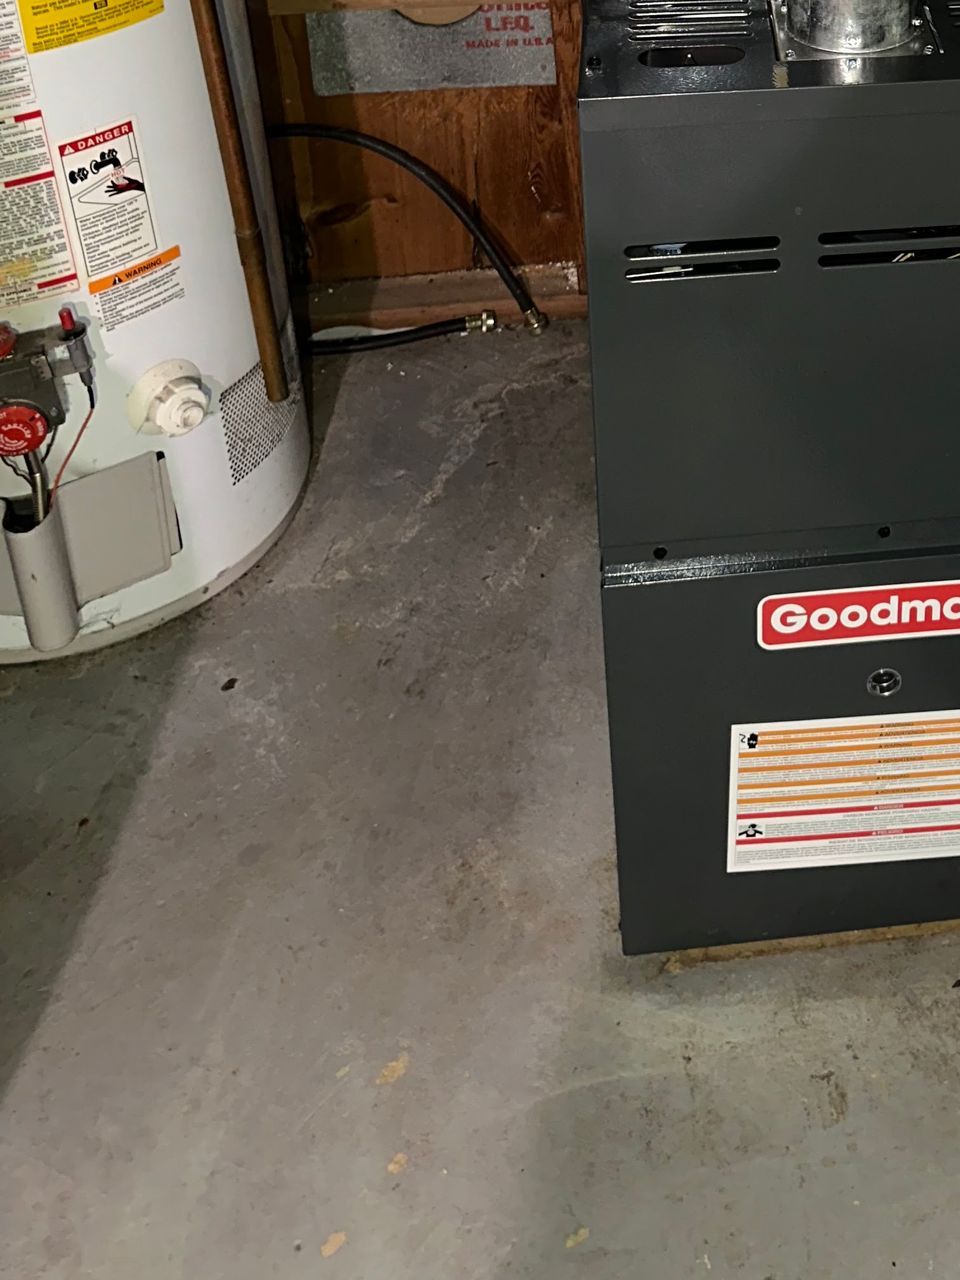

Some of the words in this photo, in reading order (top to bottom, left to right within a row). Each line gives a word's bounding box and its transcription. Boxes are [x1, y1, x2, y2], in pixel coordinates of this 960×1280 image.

[465, 39, 500, 48] MADE
[506, 38, 518, 48] IN
[77, 125, 130, 151] DANGER
[125, 257, 163, 279] WARNING
